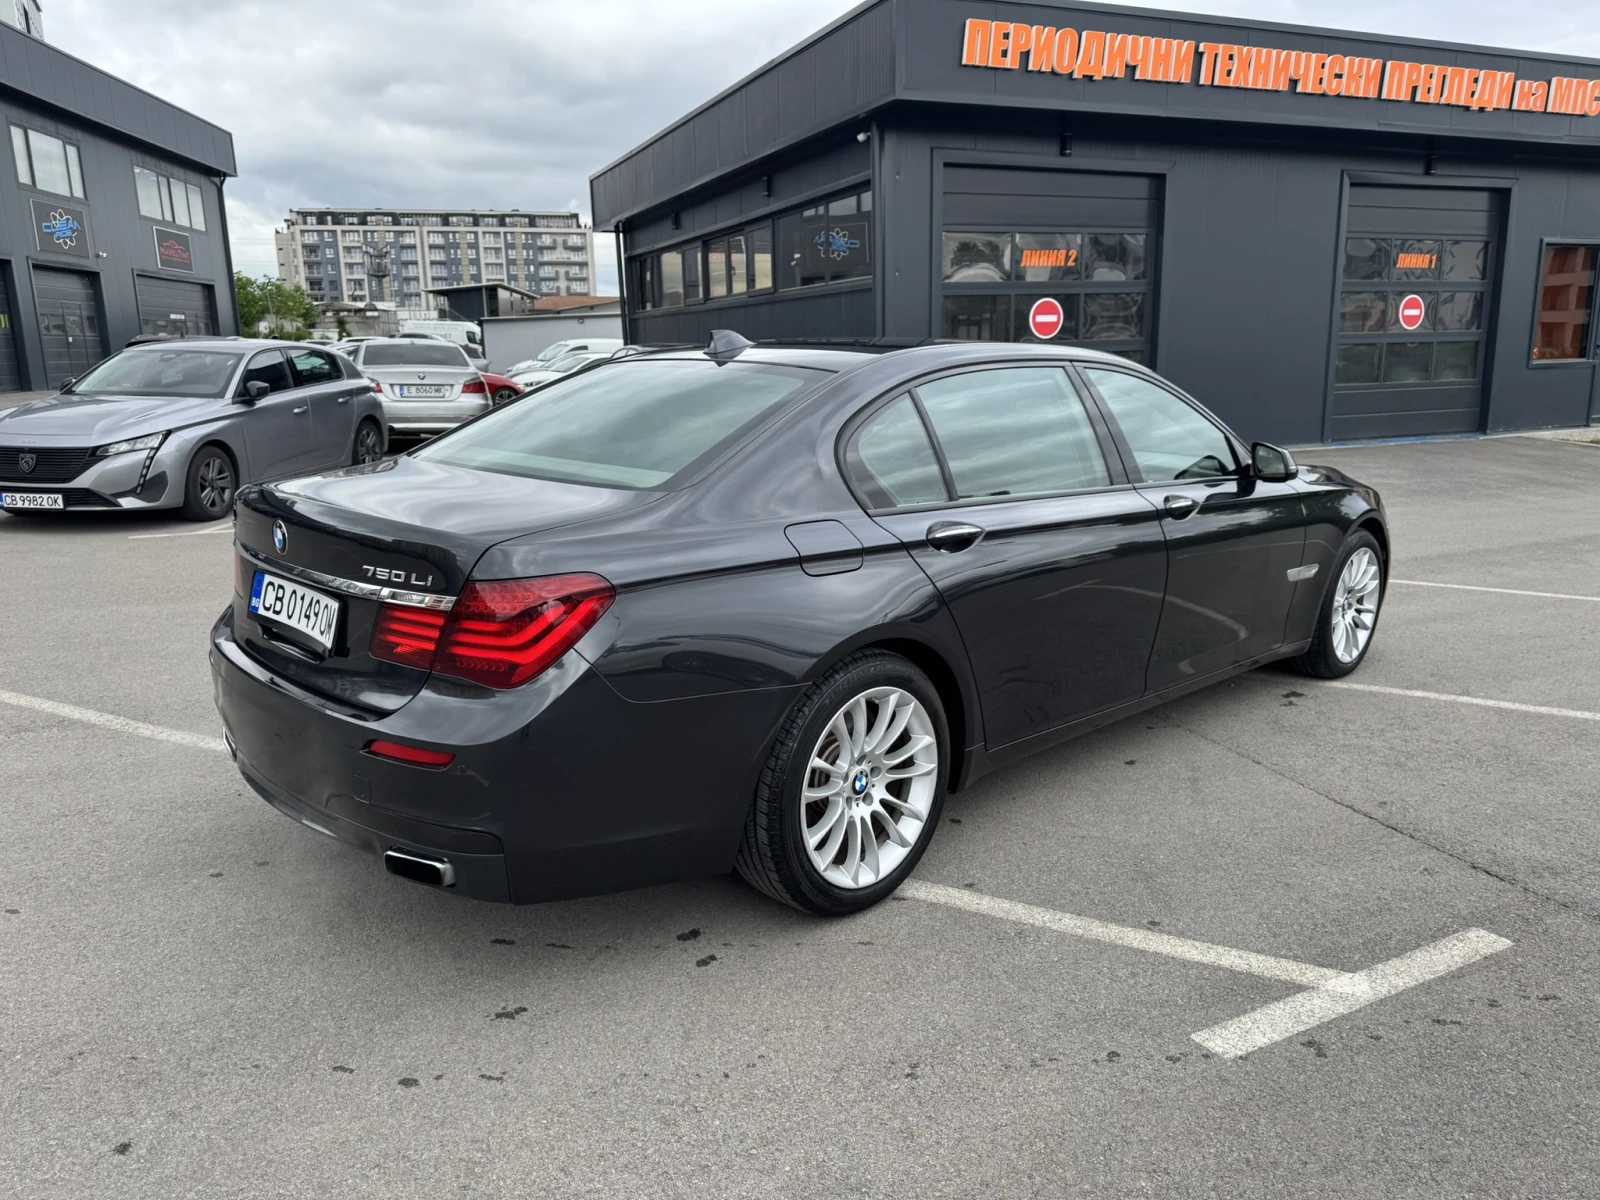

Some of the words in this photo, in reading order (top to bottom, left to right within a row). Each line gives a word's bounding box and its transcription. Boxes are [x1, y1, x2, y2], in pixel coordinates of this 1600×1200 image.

[962, 18, 1195, 83] ПЕРИОДИЧНИ
[1199, 42, 1383, 98] ТЕХНИЧЕСКИ
[1381, 61, 1515, 112] ПРЕГЛЕДИ
[1511, 80, 1549, 112] на
[1546, 77, 1600, 116] МПС
[42, 220, 81, 232] CLEAN
[1020, 249, 1067, 267] ЛИНИЯ
[1067, 249, 1077, 267] 2
[1396, 253, 1430, 268] ЛИНИЯ
[1431, 254, 1437, 269] 1
[362, 565, 406, 583] 750
[410, 573, 433, 587] Li
